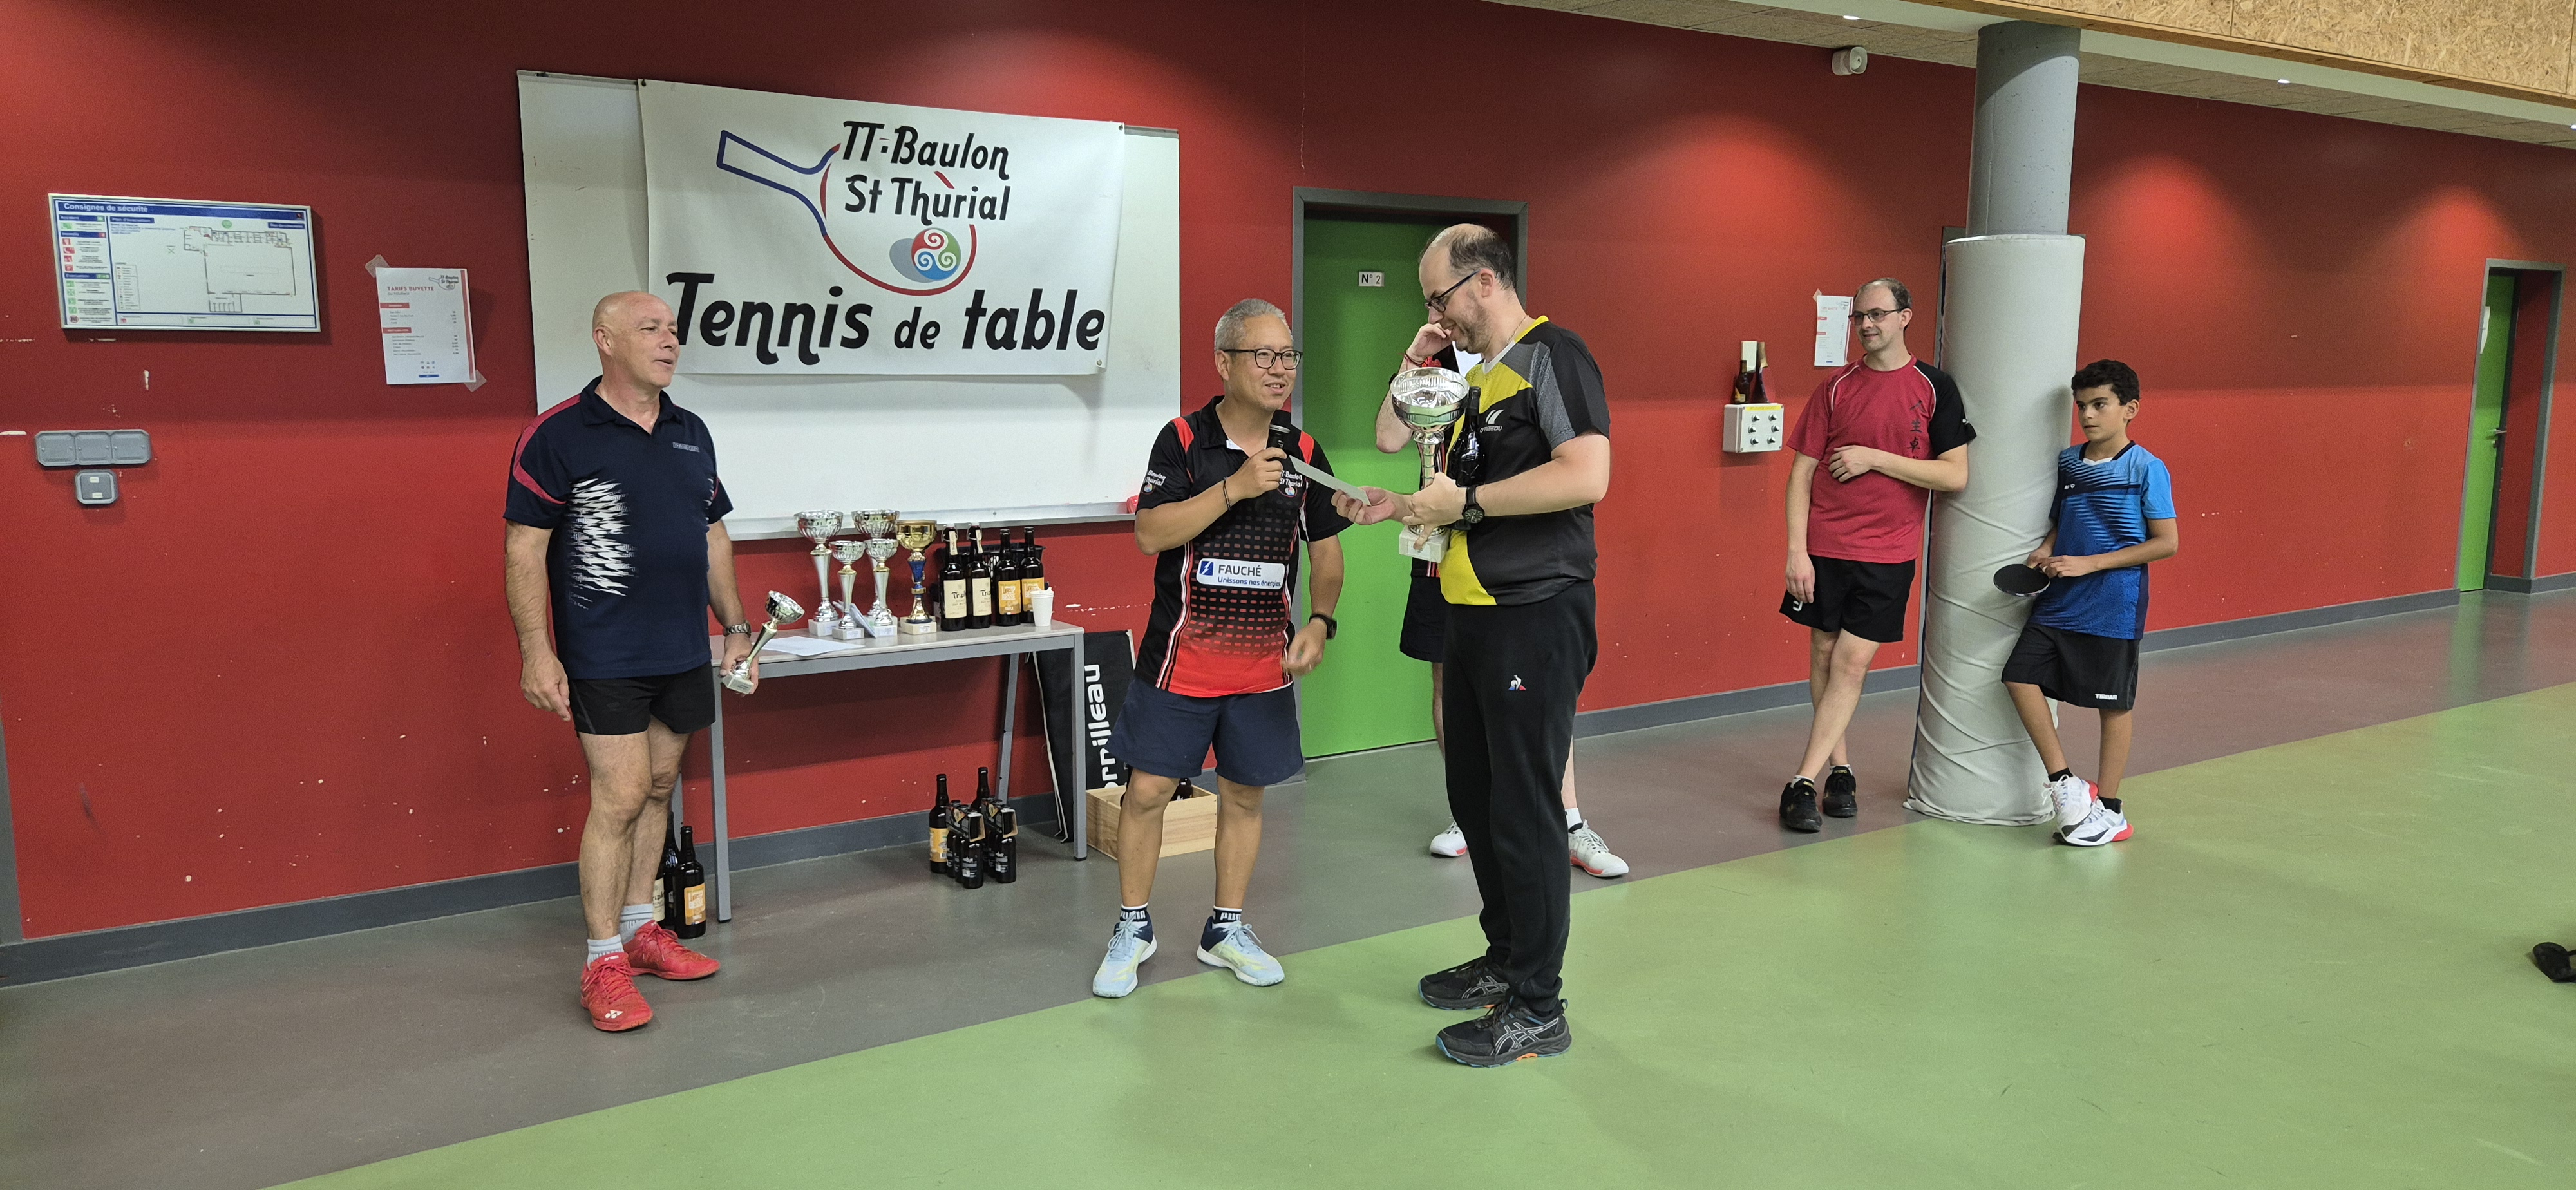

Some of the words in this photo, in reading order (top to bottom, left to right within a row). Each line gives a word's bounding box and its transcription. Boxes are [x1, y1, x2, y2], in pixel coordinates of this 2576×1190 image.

[845, 174, 883, 214] St
[890, 176, 1011, 227] Thurial
[64, 203, 105, 212] Consignes
[1361, 274, 1373, 283] N°
[1376, 275, 1381, 285] 2
[666, 271, 873, 366] Tennis
[893, 306, 941, 350] de
[961, 288, 1106, 351] table
[1218, 564, 1262, 577] FAUCHÉ
[1218, 576, 1247, 585] Unissons
[1261, 580, 1281, 588] énergies
